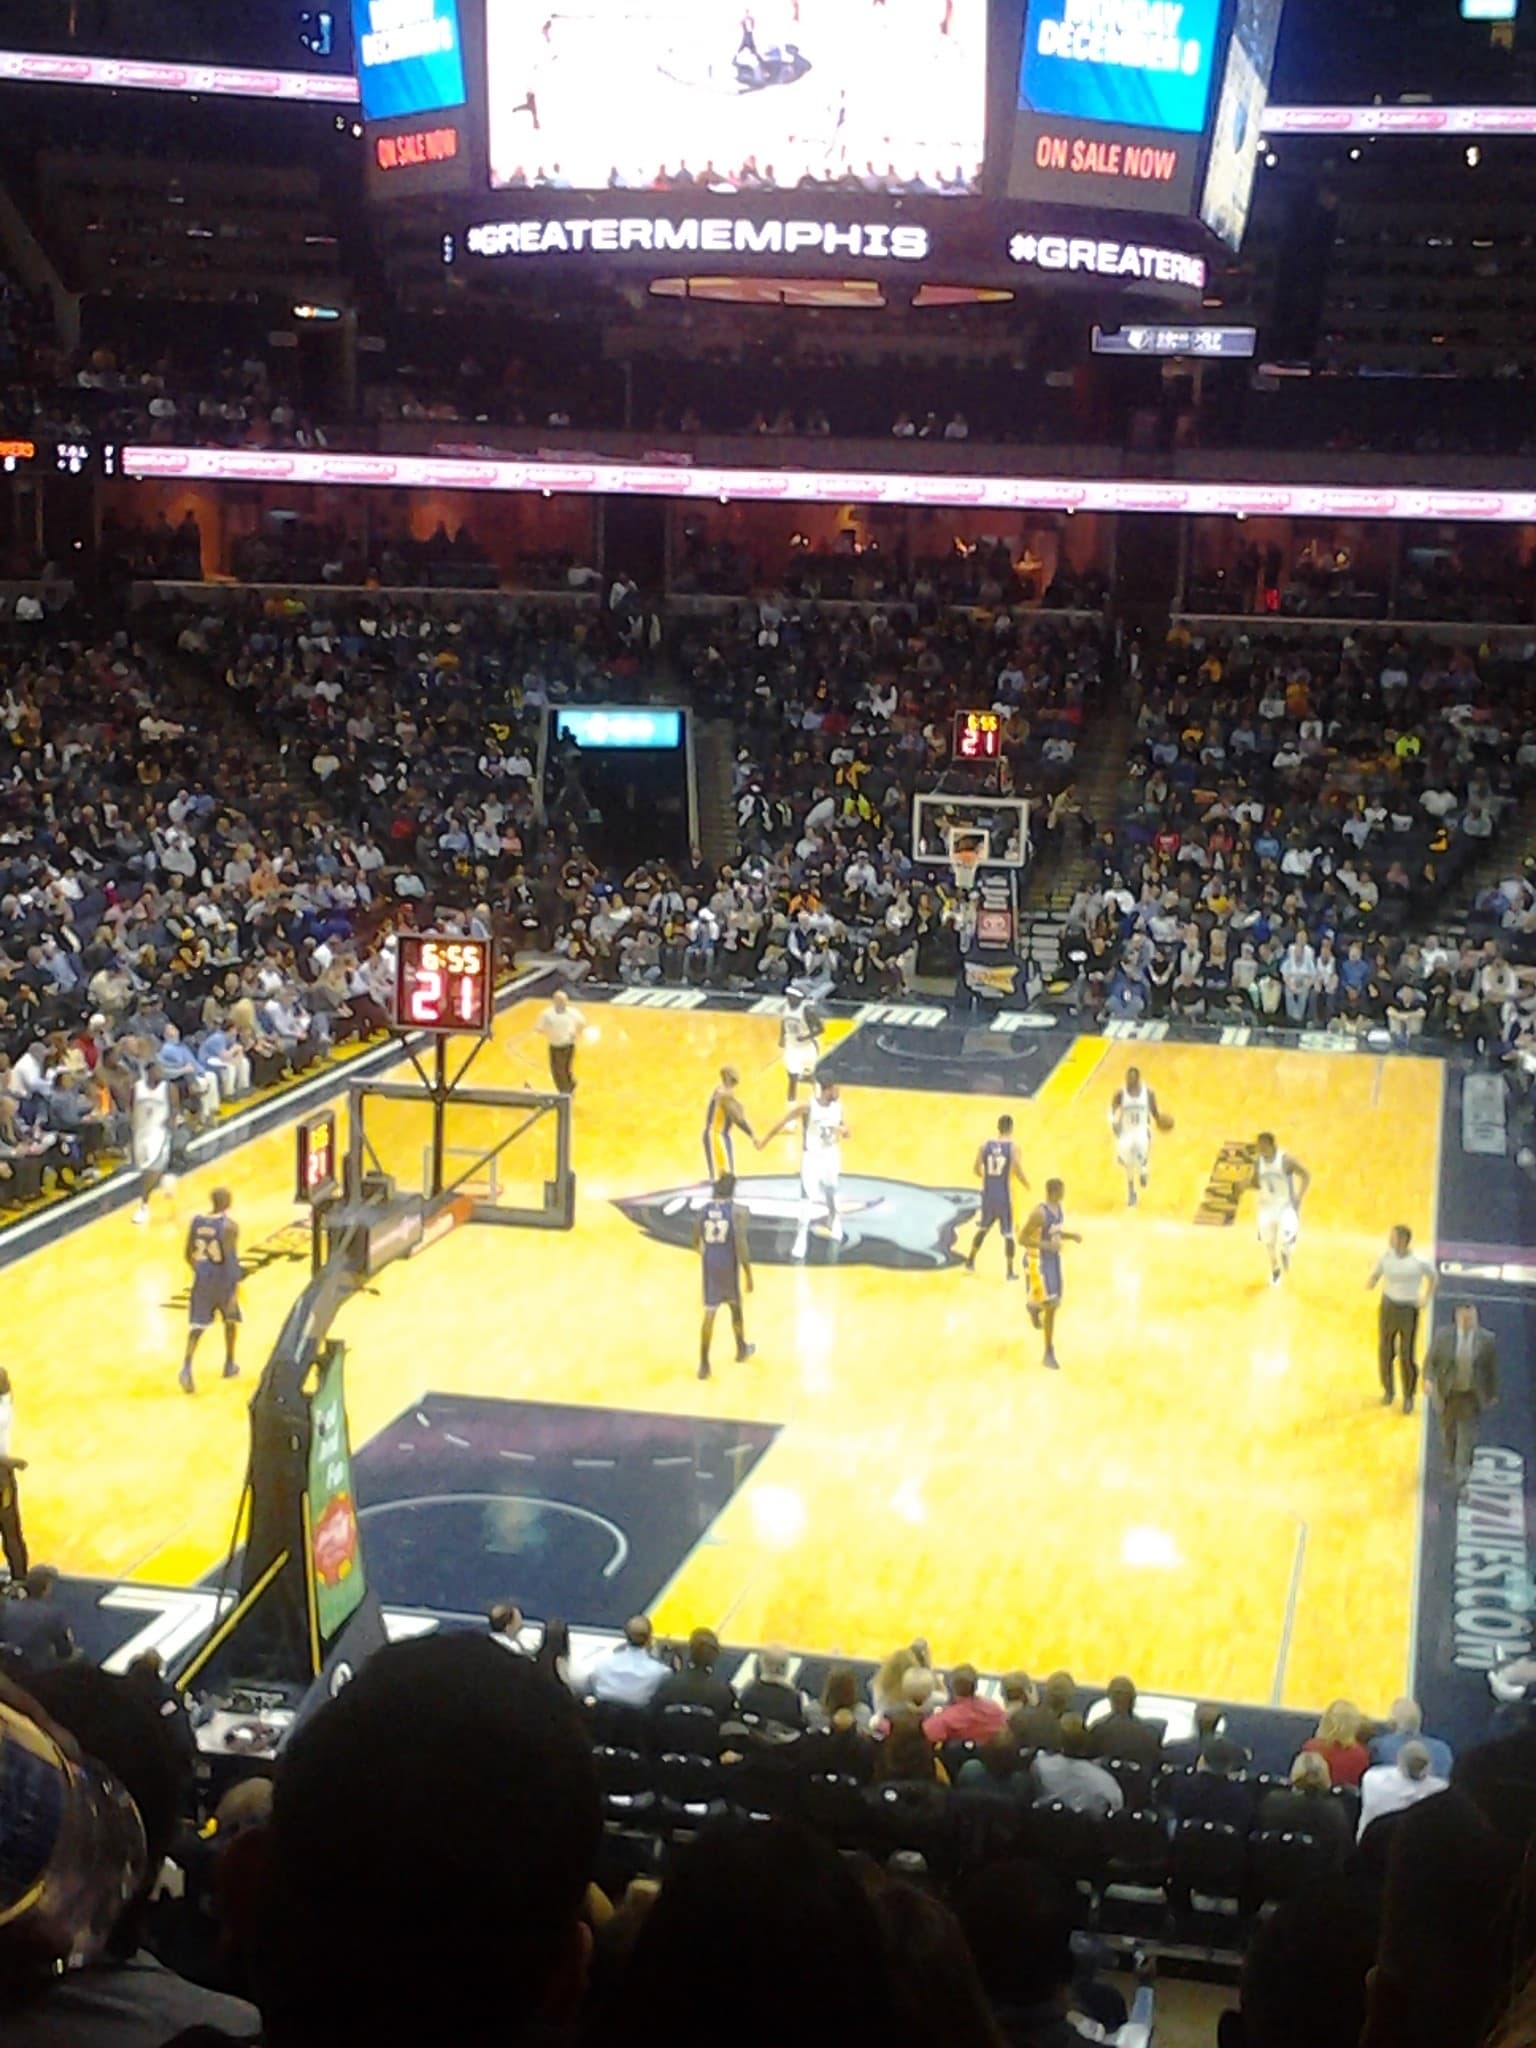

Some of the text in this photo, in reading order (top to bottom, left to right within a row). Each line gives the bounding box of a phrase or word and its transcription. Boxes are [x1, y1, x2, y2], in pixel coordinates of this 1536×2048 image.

[1036, 136, 1176, 179] ON SALE NOW
[466, 219, 930, 260] #GREATERMEMPHIS
[962, 729, 993, 755] 21
[421, 943, 480, 974] 6:55
[412, 972, 473, 1020] 21
